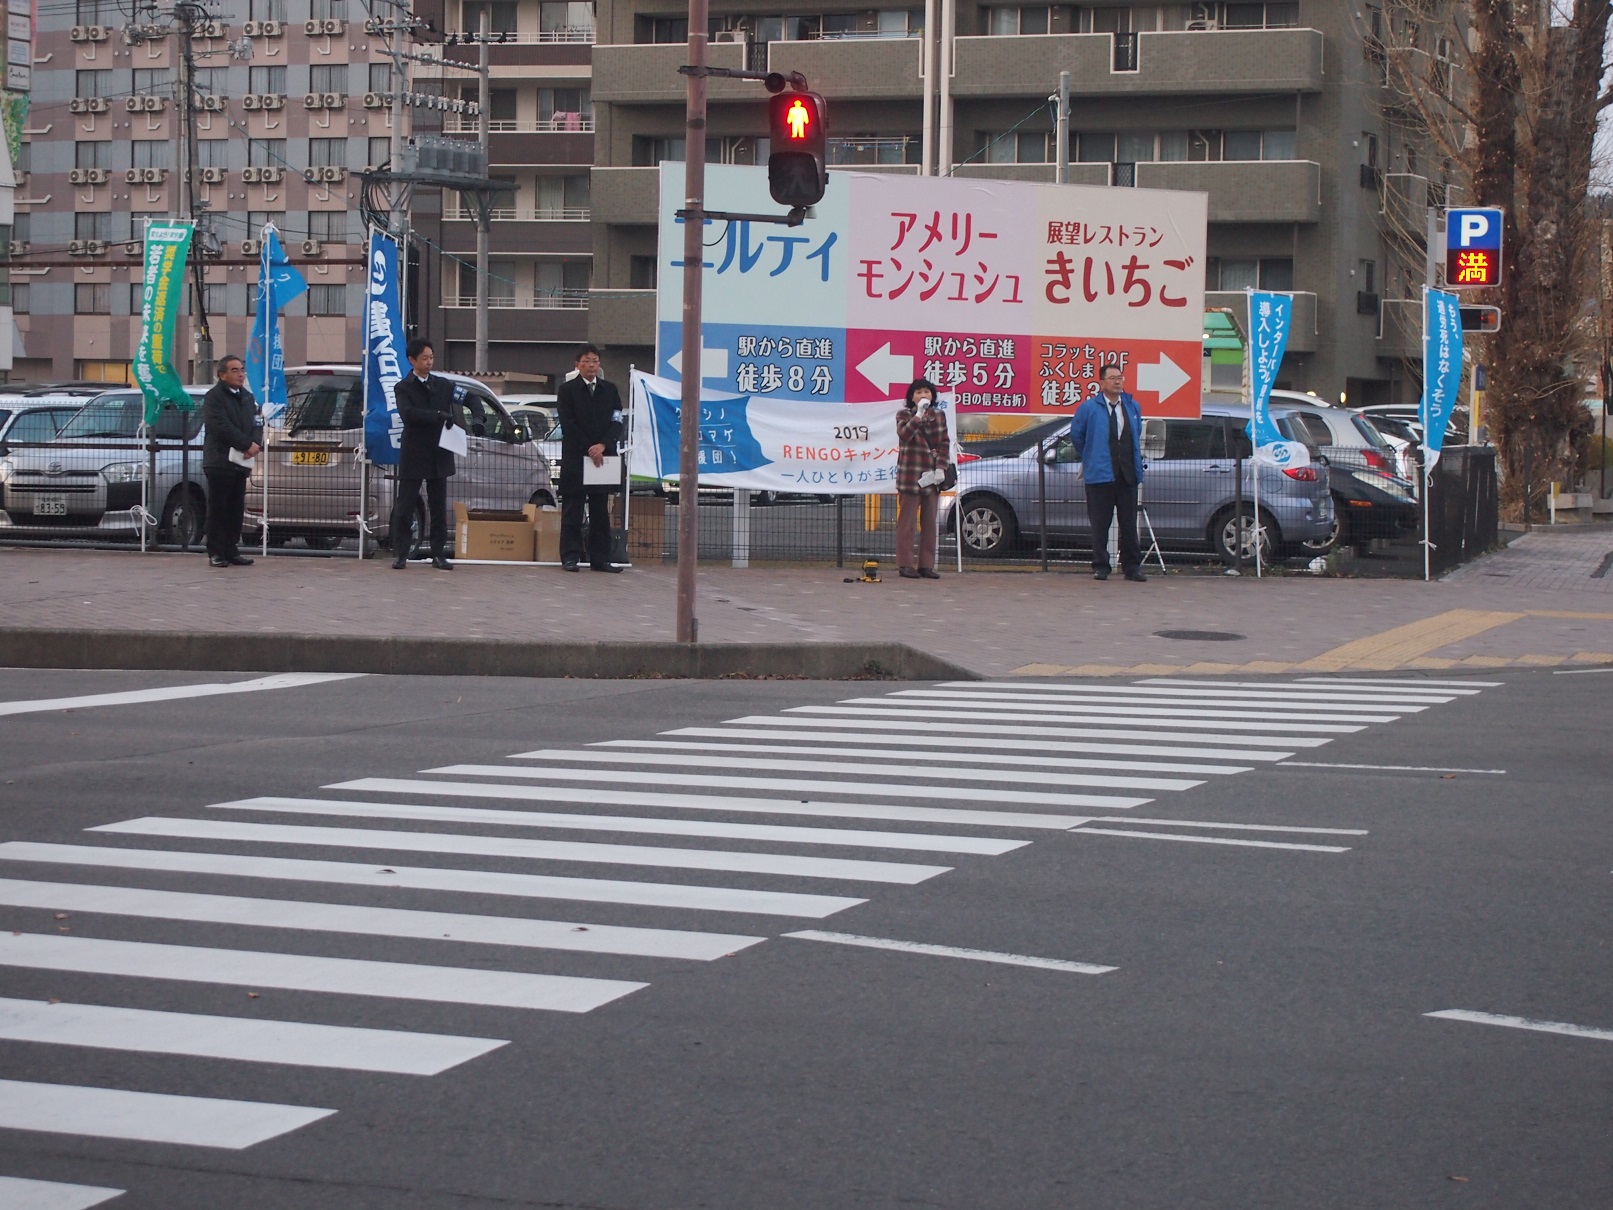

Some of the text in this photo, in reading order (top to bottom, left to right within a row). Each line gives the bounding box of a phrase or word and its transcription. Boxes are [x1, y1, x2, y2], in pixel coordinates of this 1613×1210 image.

[890, 210, 998, 256] アメリー
[1046, 221, 1164, 248] 展望レストラン
[1460, 214, 1489, 247] P
[856, 257, 1023, 304] モンシュシュ
[1044, 250, 1194, 307] きいちご
[1458, 252, 1488, 282] 満
[737, 336, 833, 360] 駅から直進
[923, 336, 1016, 359] 駅から直進
[1040, 343, 1096, 360] コラッセ
[736, 362, 834, 395] 徒歩8分
[923, 359, 1016, 389] 徒歩5分
[1039, 361, 1095, 379] ふくしま
[1040, 379, 1124, 406] 徒歩3
[833, 425, 869, 441] 2019
